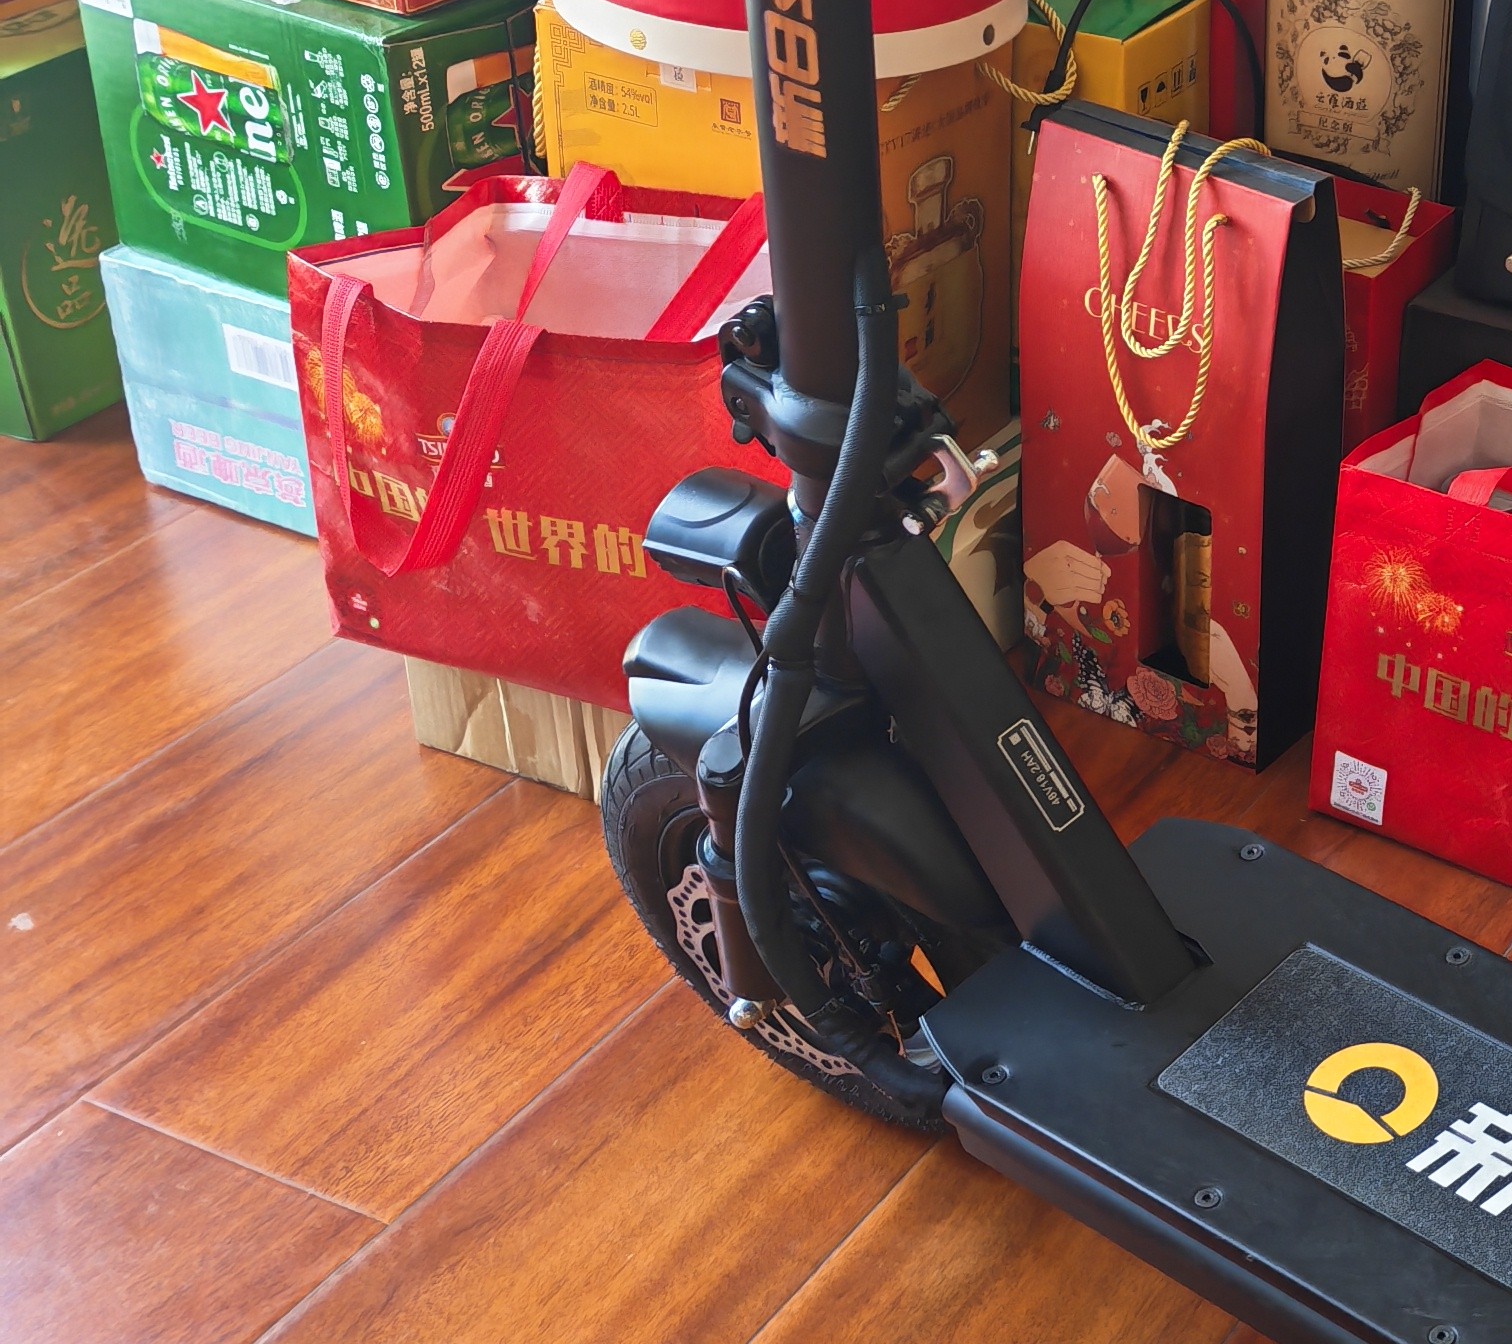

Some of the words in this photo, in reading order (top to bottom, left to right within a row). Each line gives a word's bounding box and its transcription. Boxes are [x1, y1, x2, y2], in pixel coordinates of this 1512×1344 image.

[227, 77, 277, 164] ine
[774, 10, 828, 159] 新日
[483, 506, 648, 579] 世界的
[1020, 750, 1061, 806] 48V18.2AH
